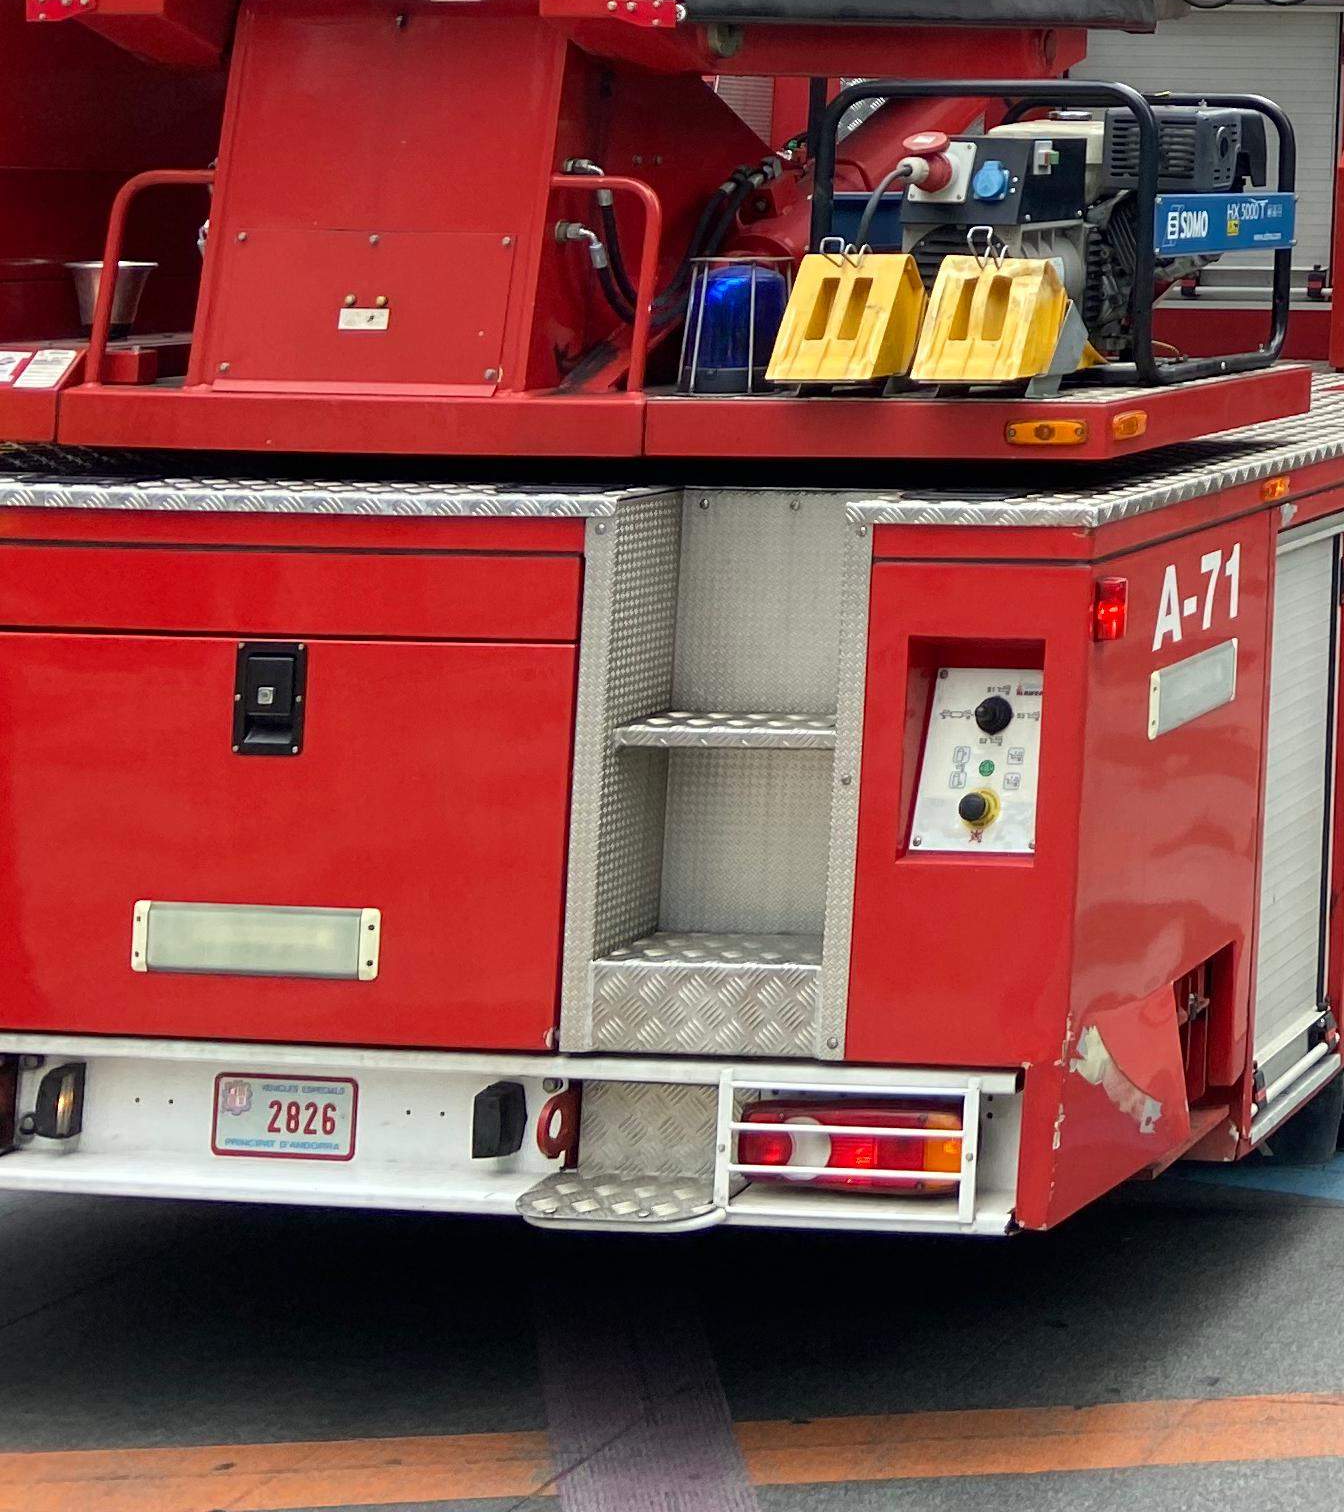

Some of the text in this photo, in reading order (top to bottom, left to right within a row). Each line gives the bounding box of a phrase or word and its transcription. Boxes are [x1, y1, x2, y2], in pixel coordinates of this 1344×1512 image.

[1180, 211, 1209, 239] SDMO
[1227, 202, 1240, 219] HX
[1151, 542, 1241, 652] A-71
[267, 1100, 337, 1135] 2826
